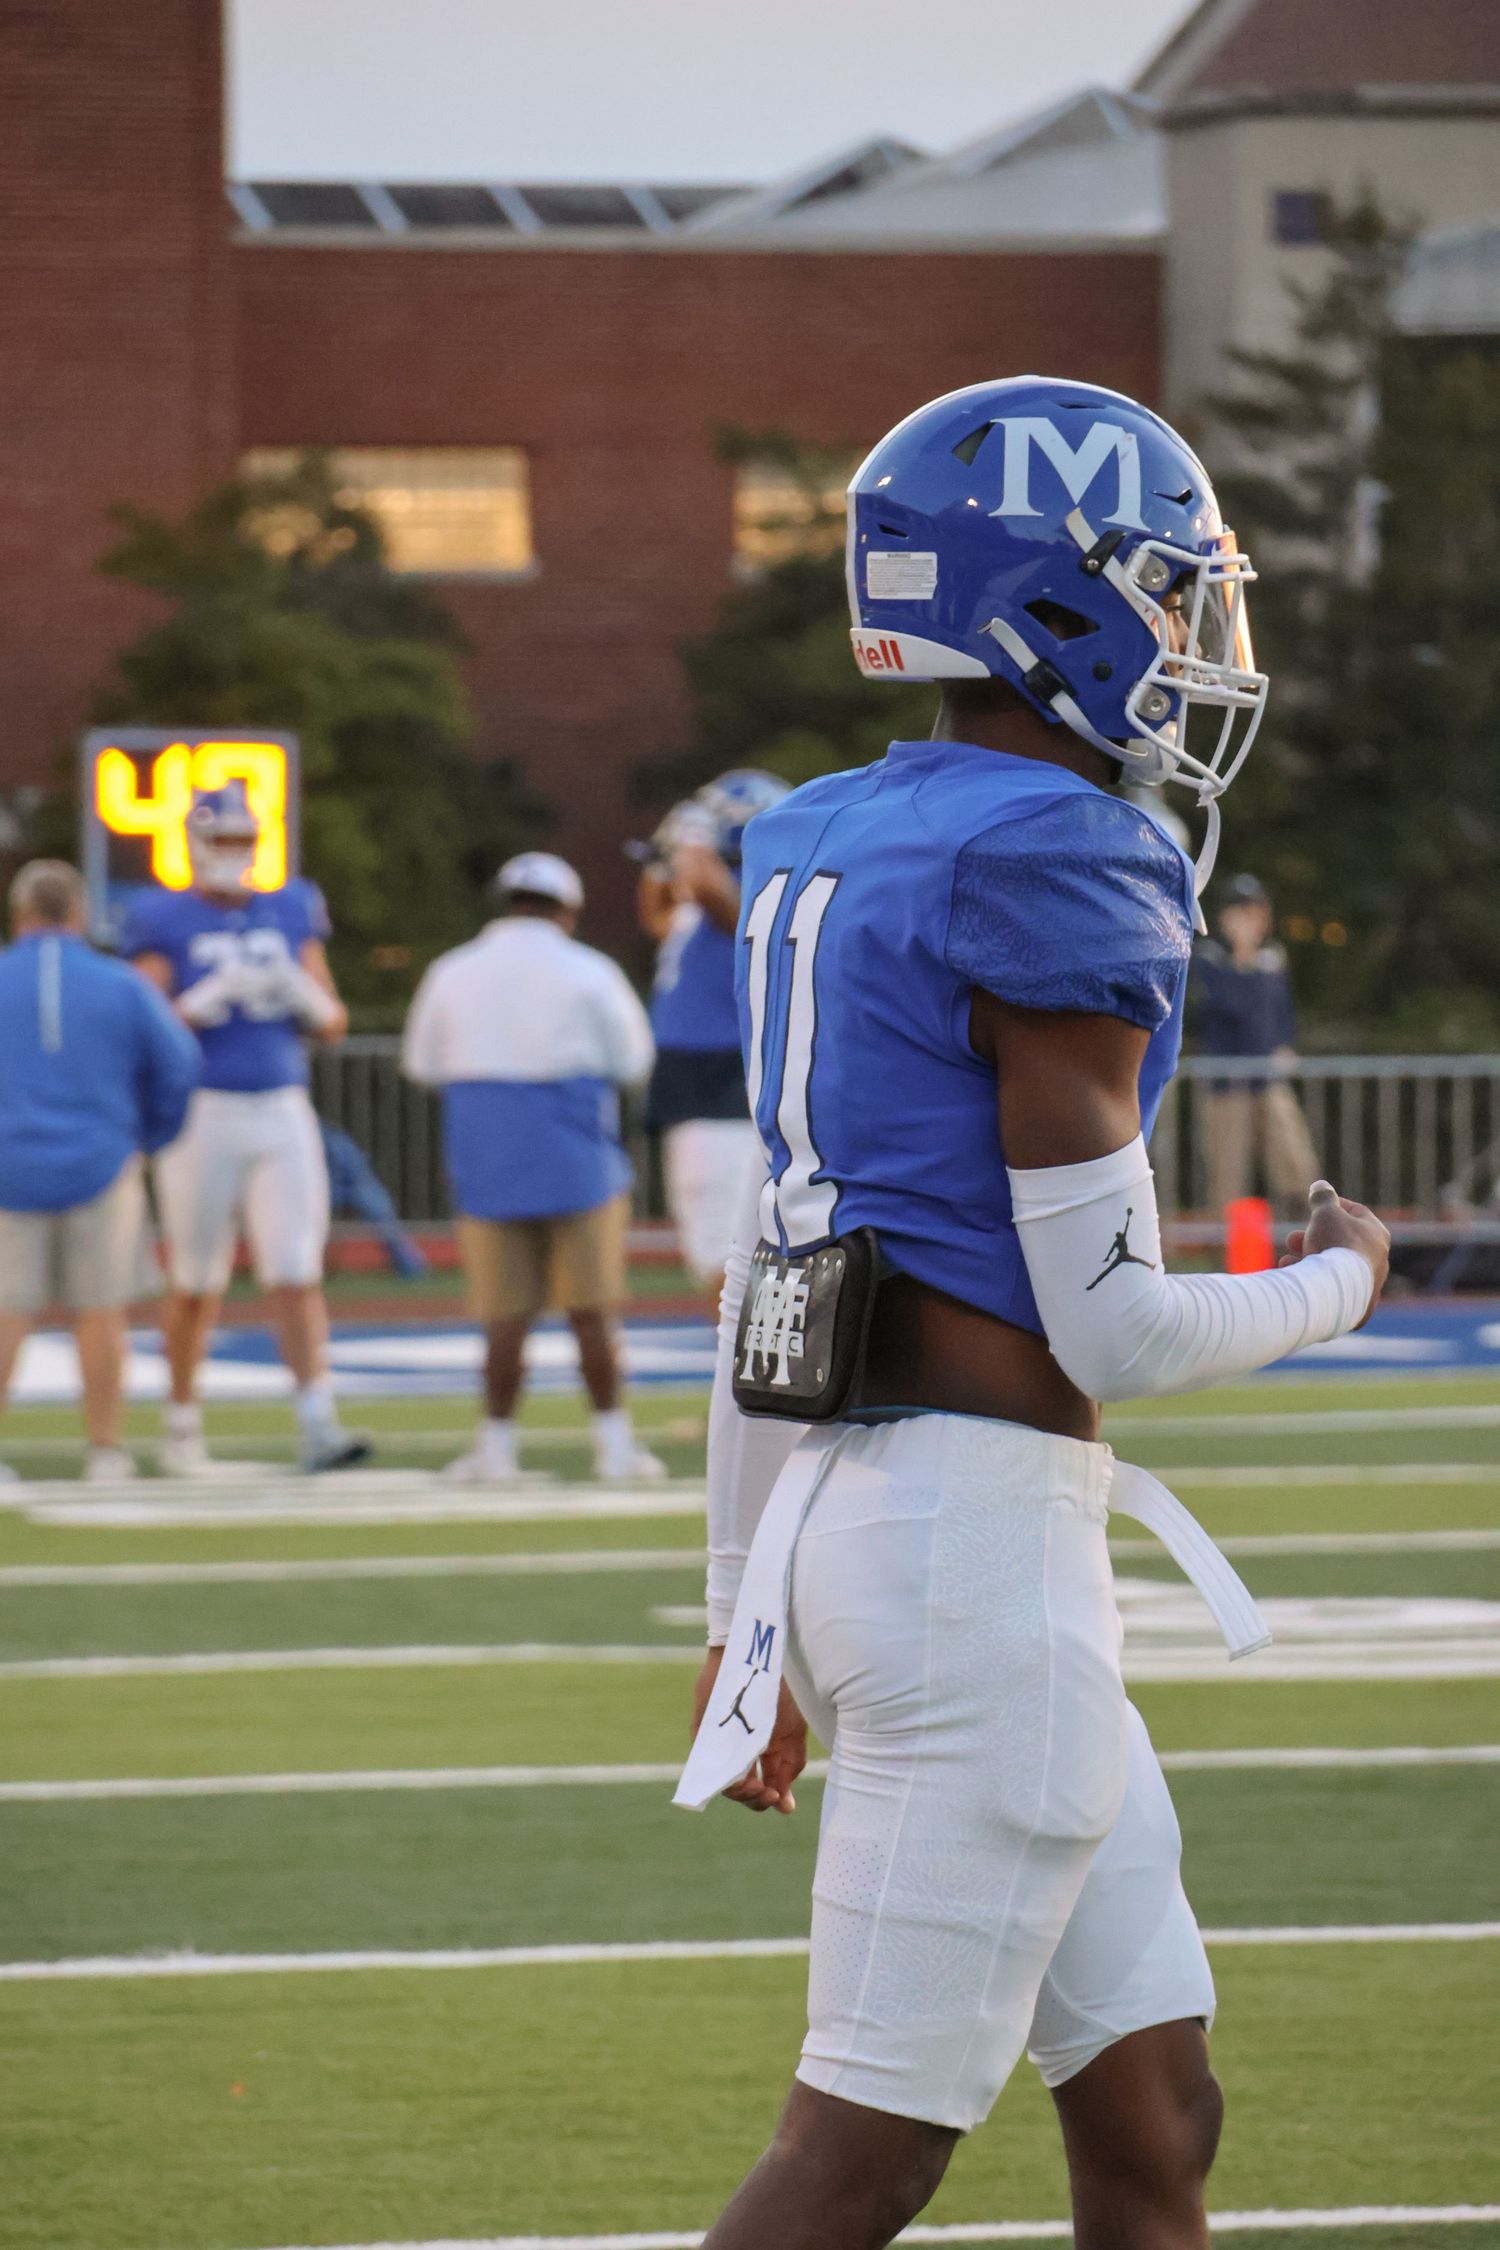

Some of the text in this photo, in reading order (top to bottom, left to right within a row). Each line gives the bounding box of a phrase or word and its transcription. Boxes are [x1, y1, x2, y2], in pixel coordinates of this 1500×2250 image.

[988, 416, 1152, 532] M
[743, 867, 844, 1257] 11
[744, 1618, 777, 1673] M
